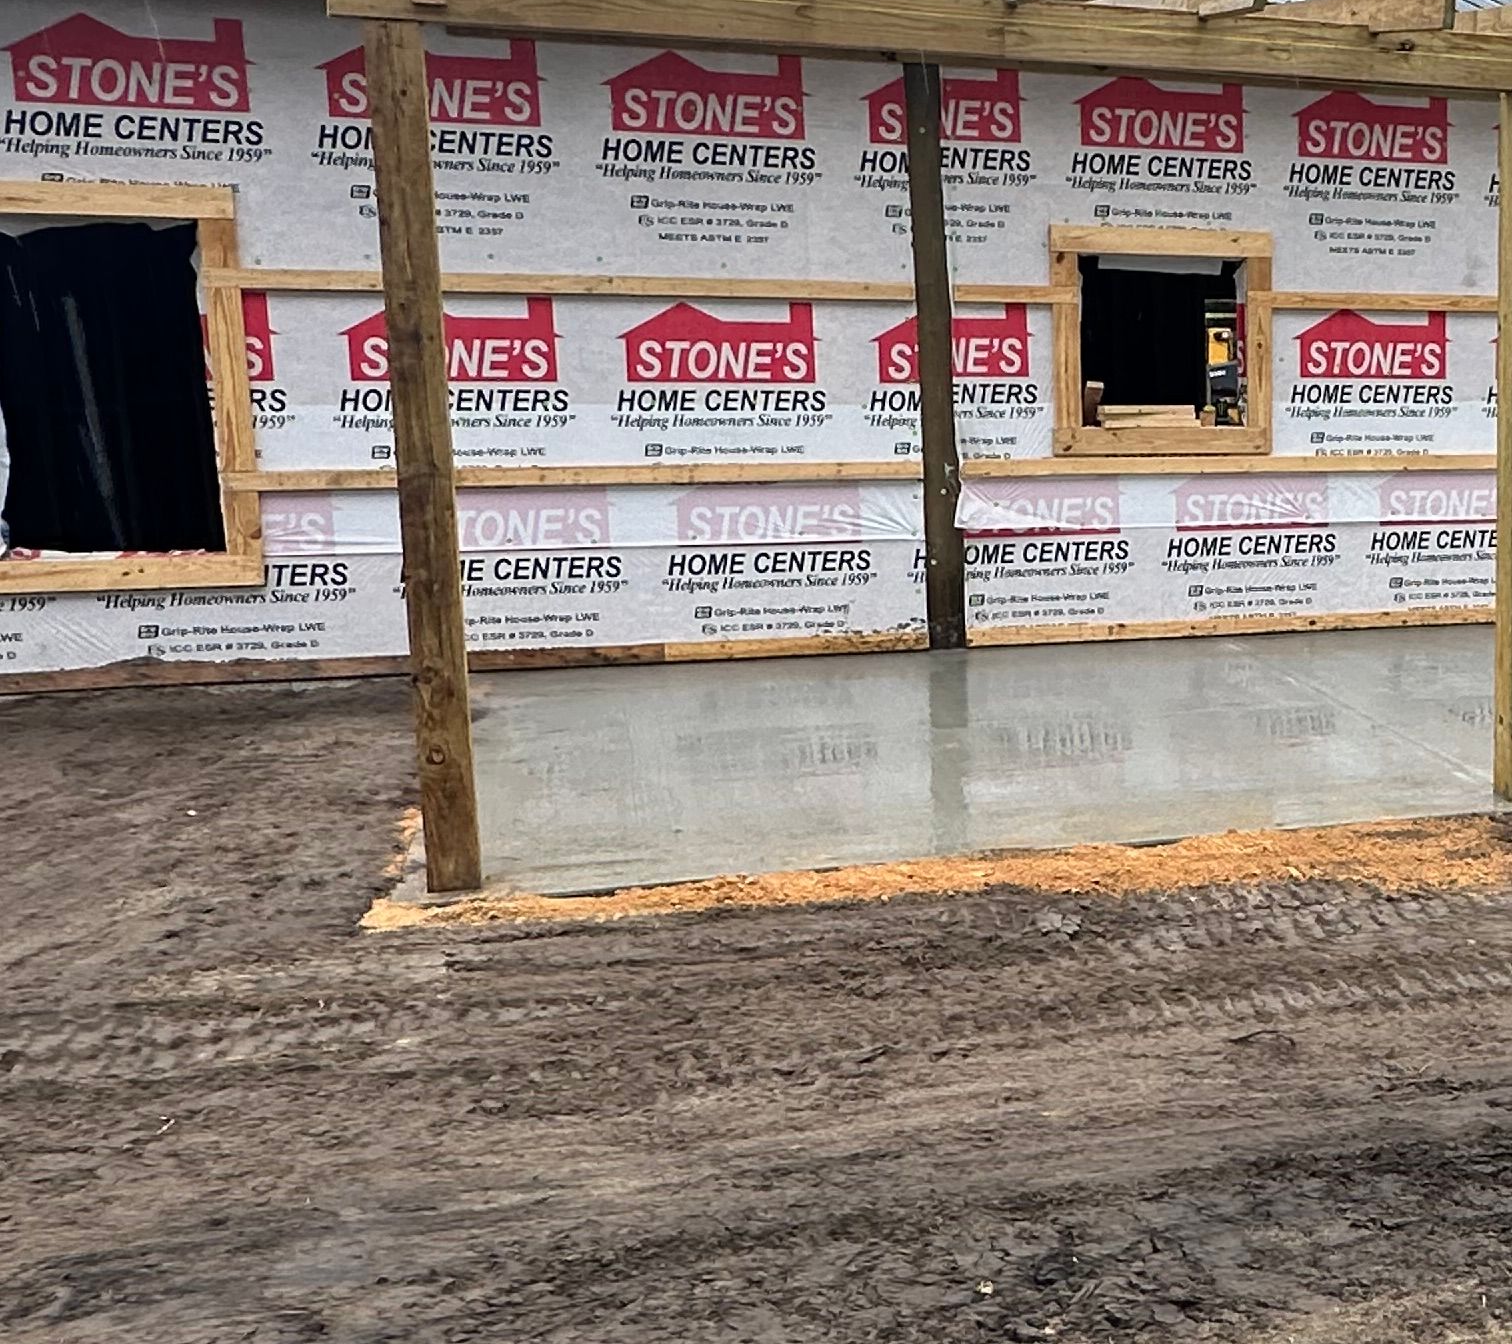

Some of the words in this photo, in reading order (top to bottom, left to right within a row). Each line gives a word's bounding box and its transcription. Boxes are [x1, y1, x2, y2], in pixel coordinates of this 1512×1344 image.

[26, 56, 238, 108] STONE'S
[339, 72, 532, 121] SNE'S
[622, 88, 797, 135] STONE'S
[4, 110, 104, 138] HOME
[114, 114, 264, 145] CENTERS
[1089, 107, 1237, 149] STONE'S
[0, 136, 70, 158] "Helping
[75, 142, 177, 160] Homeowners
[180, 145, 222, 162] Since
[227, 147, 272, 162] 1959"
[430, 130, 553, 157] ENTERS
[1306, 119, 1443, 160] STONE'S
[602, 138, 684, 164] HOME
[692, 142, 816, 170] CENTERS
[940, 147, 1031, 171] ENTERS
[477, 158, 515, 172] Since
[519, 162, 560, 174] 1959"
[595, 164, 655, 182] "Helping
[659, 168, 744, 183] Homeowners
[745, 169, 782, 184] Since
[785, 171, 822, 186] 1959"
[1072, 153, 1141, 175] HOME
[1147, 156, 1252, 181] CENTERS
[1289, 163, 1353, 186] HOME
[1359, 166, 1456, 191] CENTERS
[967, 171, 999, 186] Since
[1002, 174, 1037, 187] 1959"
[1065, 176, 1116, 192] "Helping
[1119, 178, 1191, 193] Homeowners
[1192, 181, 1223, 194] Since
[1225, 182, 1257, 195] 1959"
[360, 336, 549, 378] SNE'S
[636, 341, 808, 379] STONE'S
[1307, 341, 1441, 375] STONE'S
[617, 390, 696, 412] HOME
[705, 390, 826, 412] CENTERS
[1291, 384, 1353, 404] HOME
[1359, 385, 1454, 404] CENTERS
[494, 415, 531, 428] Since
[536, 415, 576, 429] 1959"
[610, 415, 669, 431] "Helping
[672, 415, 754, 428] Homeowners
[758, 415, 792, 427] Since
[795, 415, 833, 427] 1959"
[864, 416, 917, 428] "Helping
[974, 409, 1006, 418] Since
[1009, 407, 1044, 418] 1959"
[1285, 406, 1331, 419] "Helping
[1334, 407, 1396, 419] Homeowners
[1399, 407, 1425, 417] Since
[1428, 406, 1458, 418] 1959"
[460, 509, 602, 545] TONE'S
[688, 505, 856, 540] STONE'S
[1167, 536, 1232, 557] HOME
[1238, 534, 1336, 554] CENTERS
[1371, 531, 1430, 551] HOME
[1436, 529, 1497, 549] CENTE
[668, 554, 746, 576] HOME
[754, 550, 871, 573] CENTERS
[964, 543, 1016, 565] OME
[1023, 541, 1129, 562] CENTERS
[494, 556, 622, 579] CENTERS
[550, 582, 585, 595] Since
[589, 581, 629, 593] 1959"
[662, 578, 719, 593] "Helping
[722, 577, 802, 591] Homeowners
[805, 575, 838, 588] Since
[841, 573, 878, 586] 1959"
[97, 593, 165, 610] "Helping
[170, 590, 266, 605] Homeowners
[271, 589, 309, 602] Since
[314, 588, 356, 602] 1959"
[299, 623, 326, 632] LWE
[575, 613, 600, 622] LWE
[309, 640, 319, 648] D
